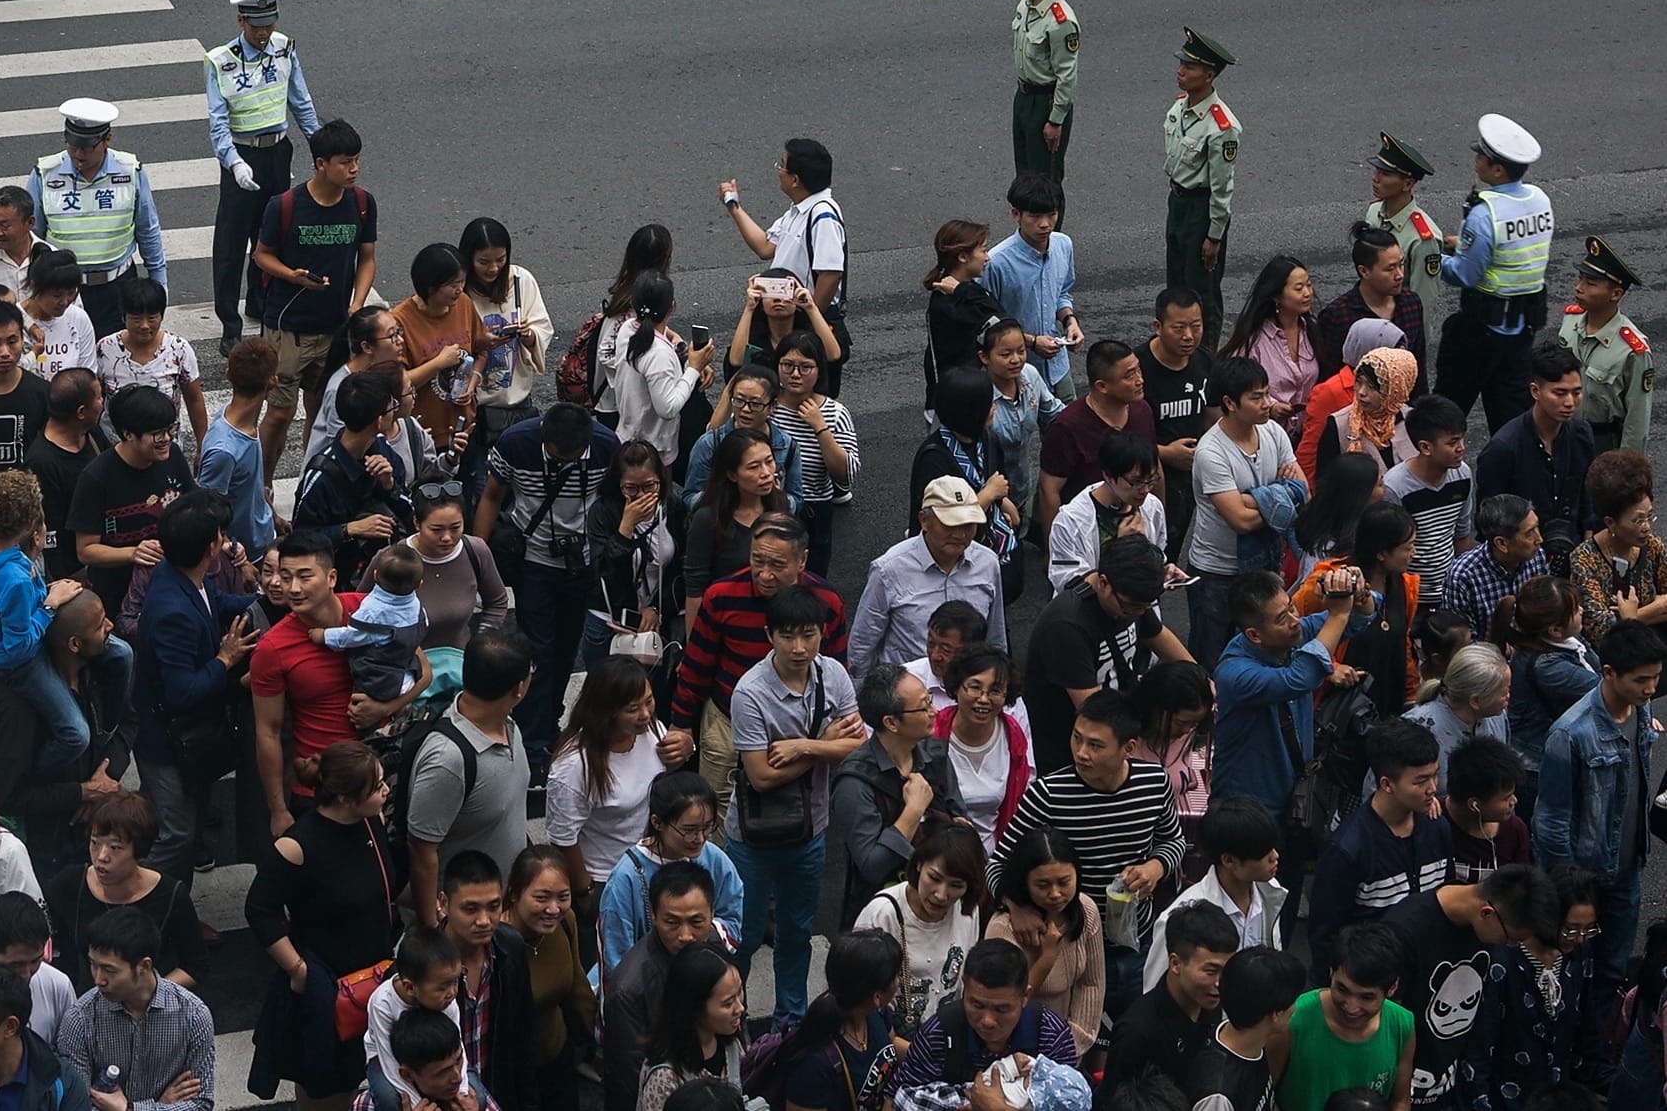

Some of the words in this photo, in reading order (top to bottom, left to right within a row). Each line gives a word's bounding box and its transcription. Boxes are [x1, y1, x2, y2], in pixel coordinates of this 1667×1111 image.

[234, 63, 278, 91] 交管
[62, 189, 115, 211] 交管
[1505, 211, 1552, 241] POLICE
